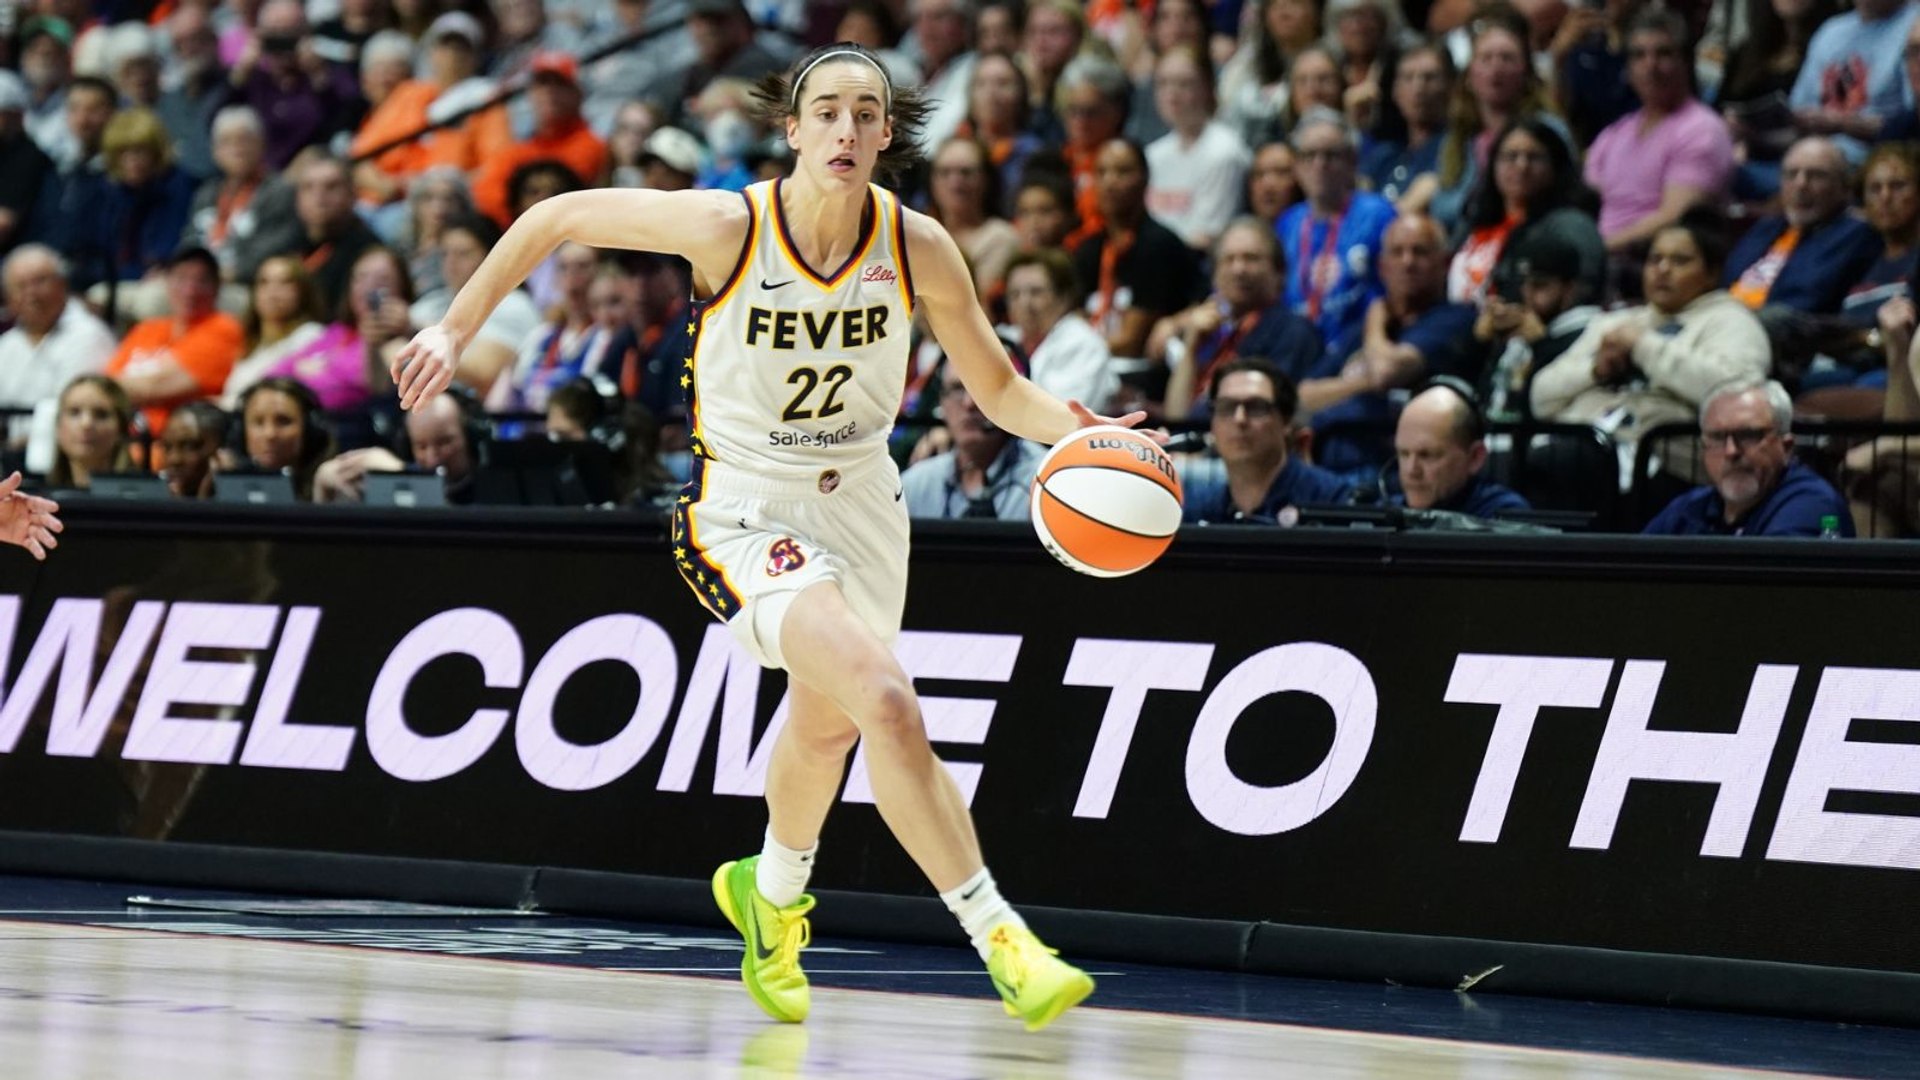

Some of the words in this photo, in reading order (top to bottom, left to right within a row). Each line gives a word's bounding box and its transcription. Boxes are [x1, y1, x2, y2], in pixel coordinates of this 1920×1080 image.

[862, 265, 897, 286] Lilly
[745, 304, 889, 350] FEVER
[781, 364, 854, 423] 22
[1061, 637, 1379, 837] TO
[1443, 652, 1920, 870] THE
